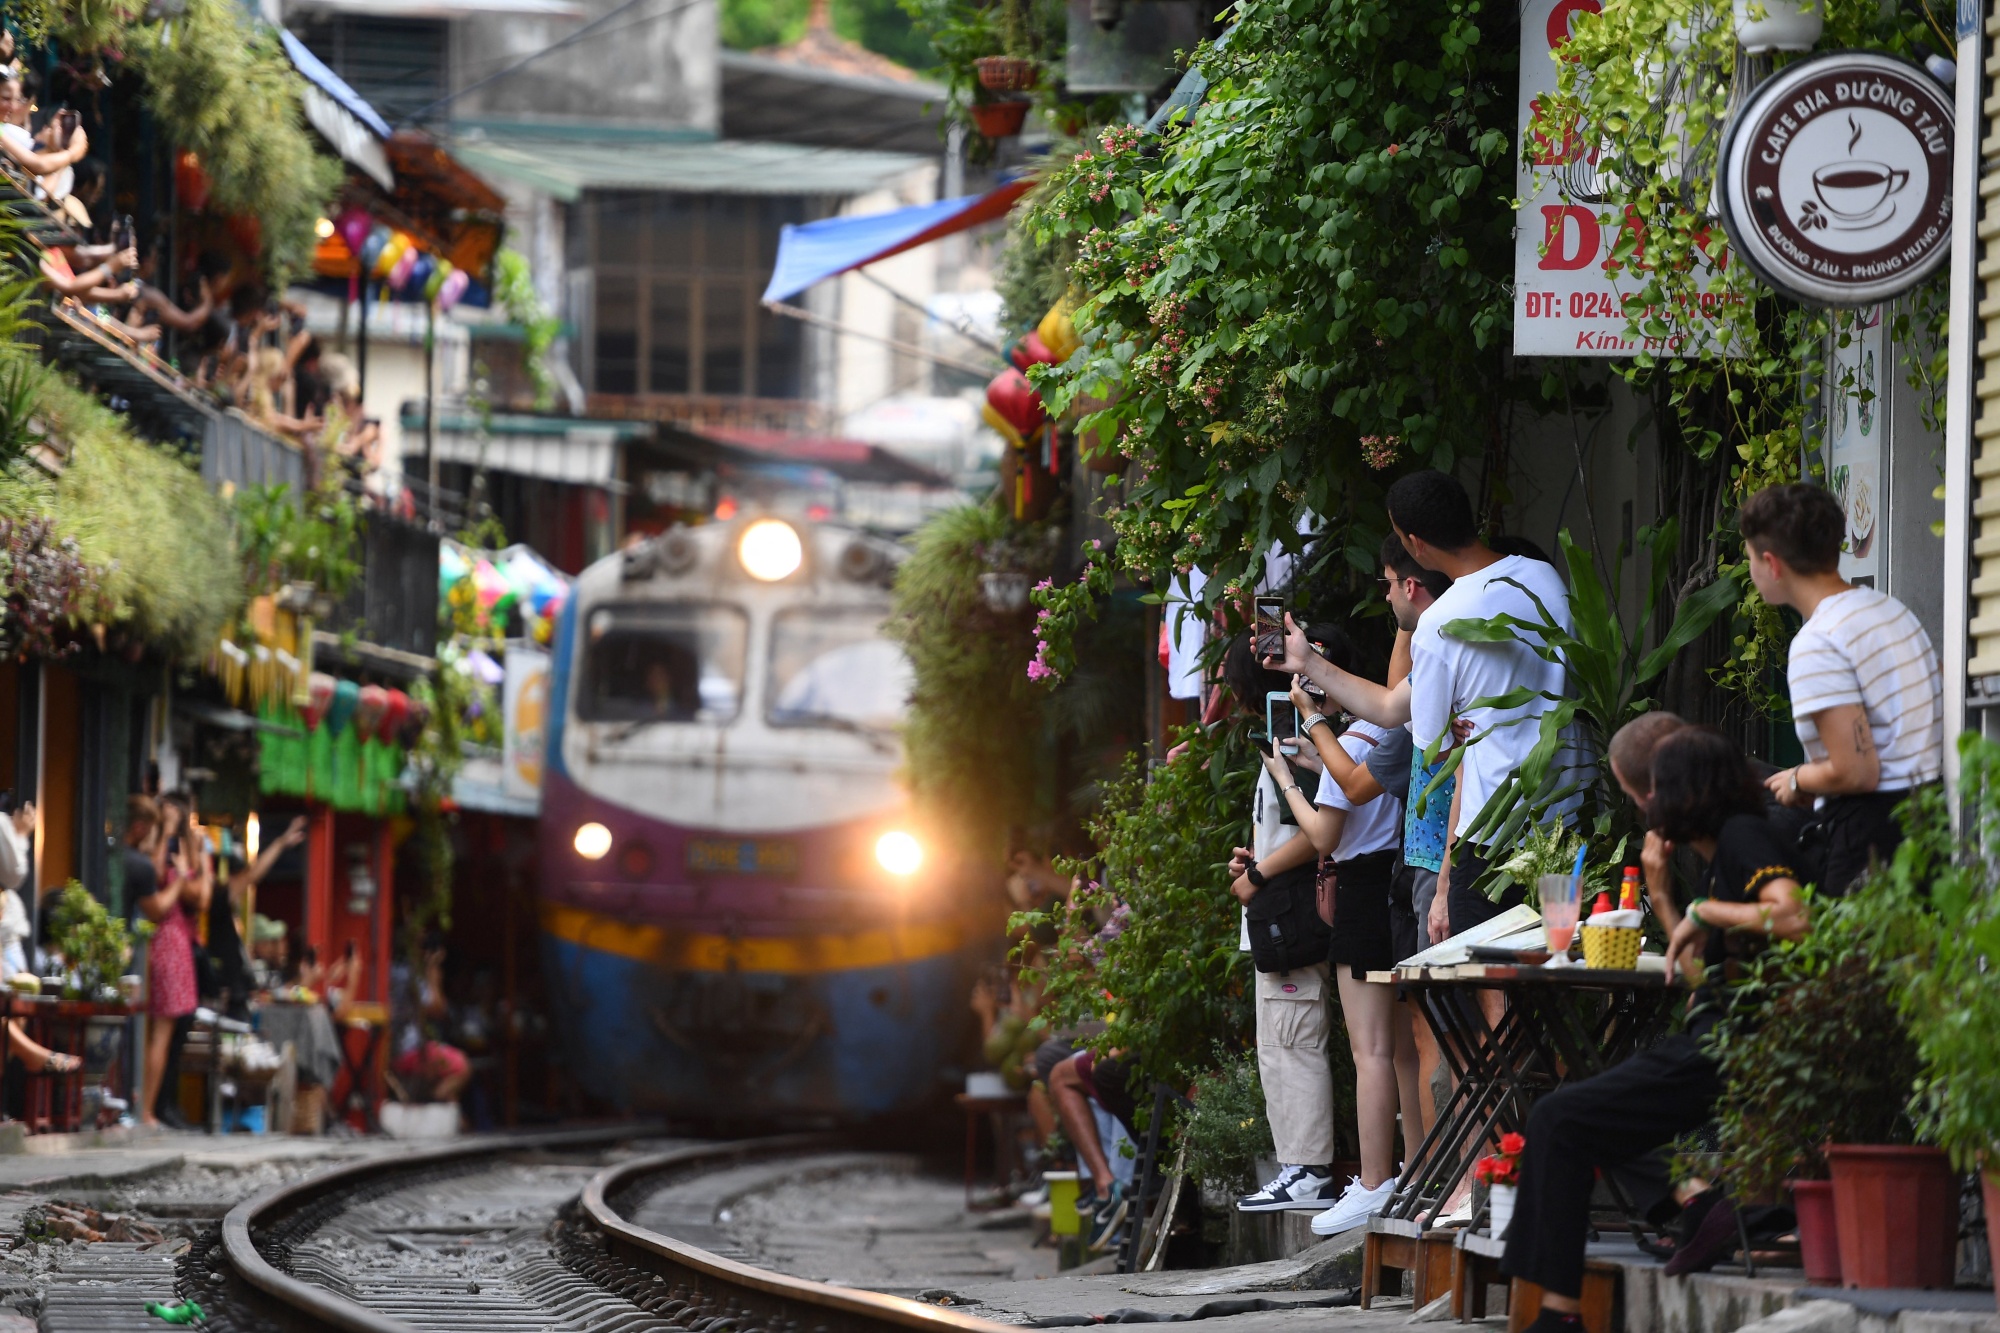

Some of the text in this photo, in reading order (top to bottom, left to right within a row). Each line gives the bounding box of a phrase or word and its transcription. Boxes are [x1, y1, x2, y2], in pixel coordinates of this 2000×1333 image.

[1761, 77, 1947, 164] CAFE BIA ĐƯỜNG TÀU
[1767, 224, 1811, 266] ĐƯỜNG
[1812, 258, 1840, 277] TÀU
[1852, 256, 1902, 278] PHÙNG
[1902, 226, 1939, 263] HƯNG
[1525, 291, 1562, 318] ĐT:
[1643, 330, 1693, 350] mờ
